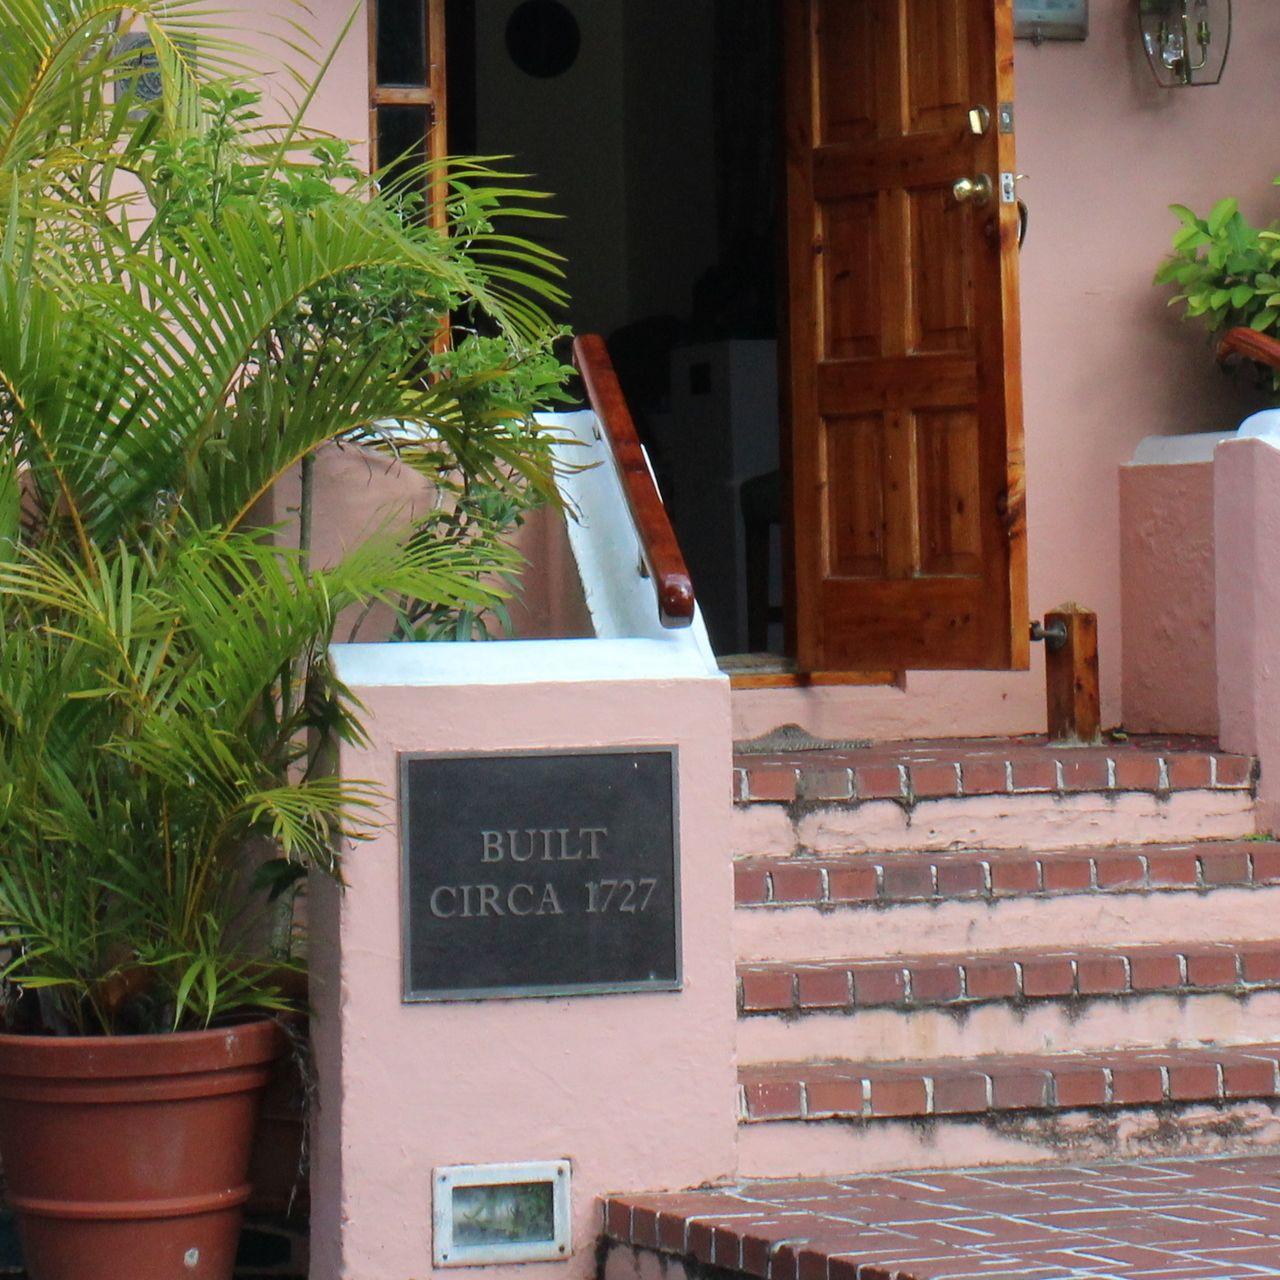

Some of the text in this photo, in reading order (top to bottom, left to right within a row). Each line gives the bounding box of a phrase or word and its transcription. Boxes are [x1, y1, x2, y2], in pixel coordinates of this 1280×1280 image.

[480, 826, 608, 863] BUILT
[429, 878, 658, 919] CIRCA 1727
